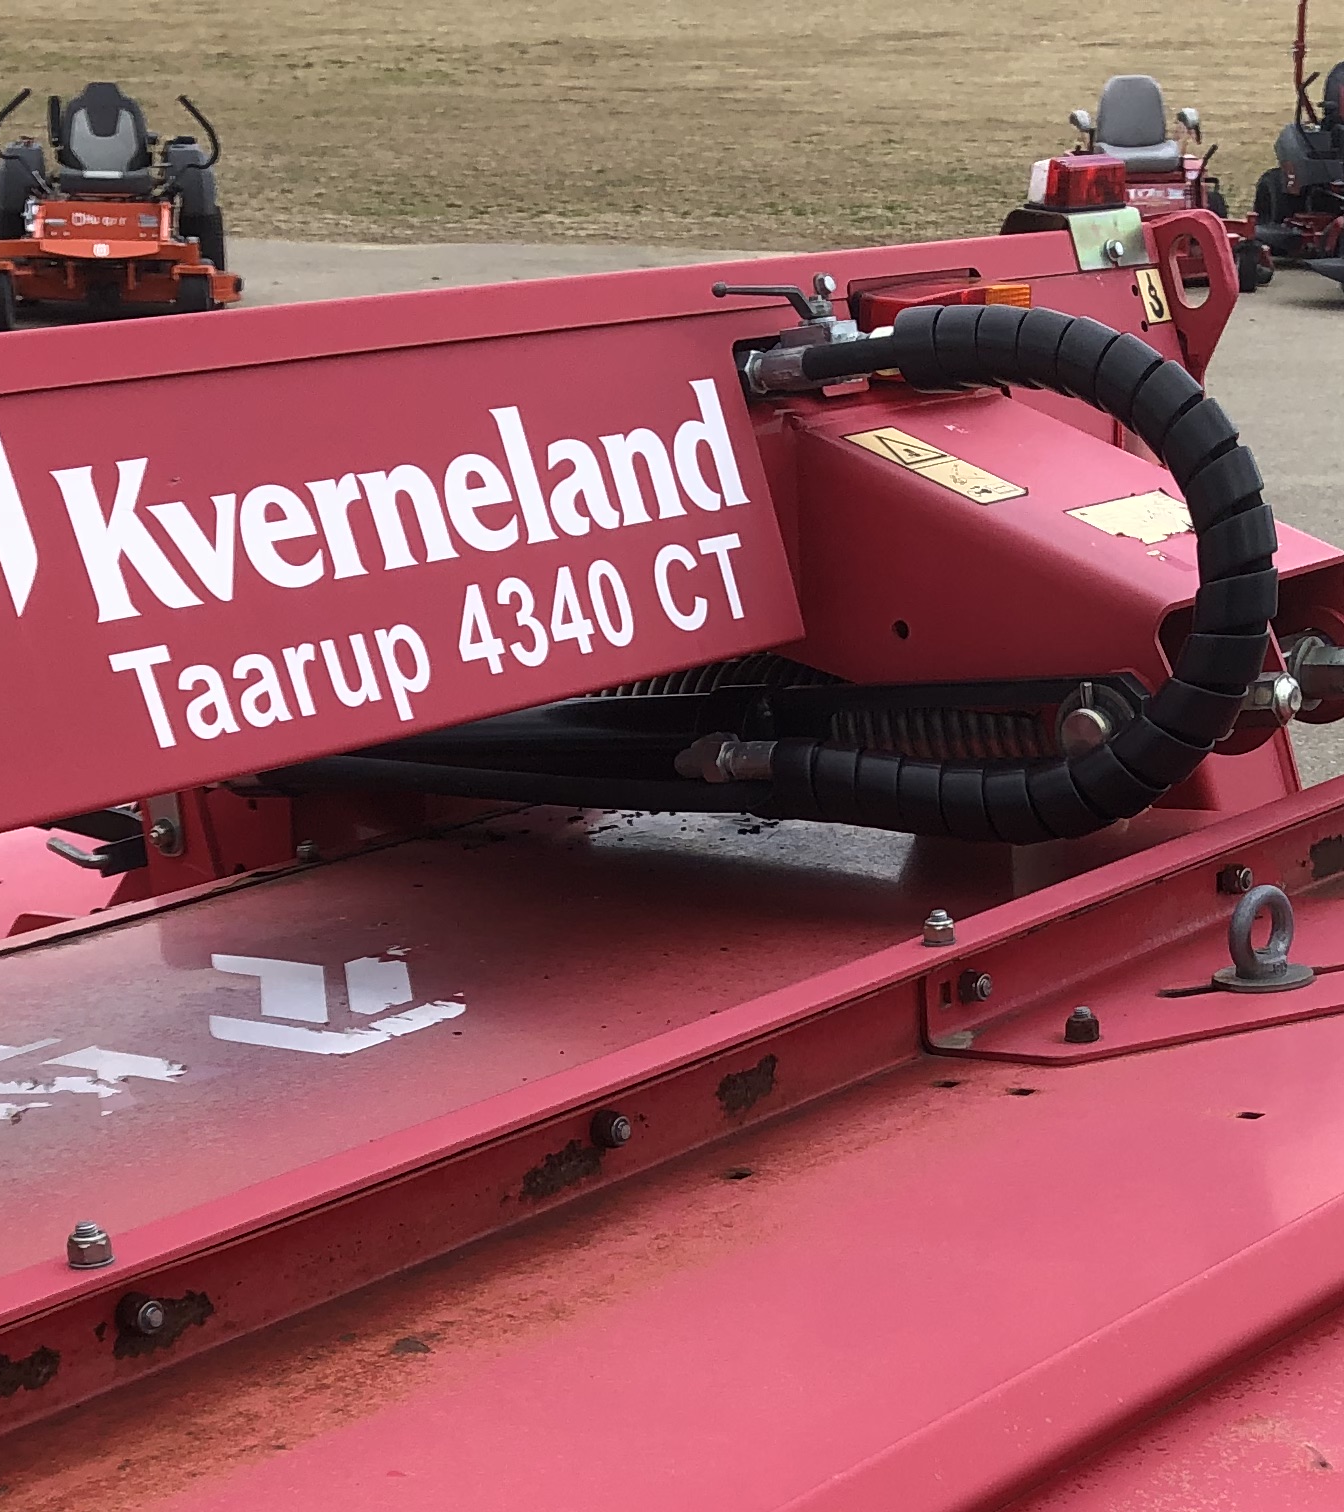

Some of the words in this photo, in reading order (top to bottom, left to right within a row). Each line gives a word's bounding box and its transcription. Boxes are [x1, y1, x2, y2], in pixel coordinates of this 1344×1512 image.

[50, 378, 751, 624] Kverneland
[109, 624, 431, 749] Taarup
[458, 559, 635, 675] 4340
[654, 532, 745, 632] CT
